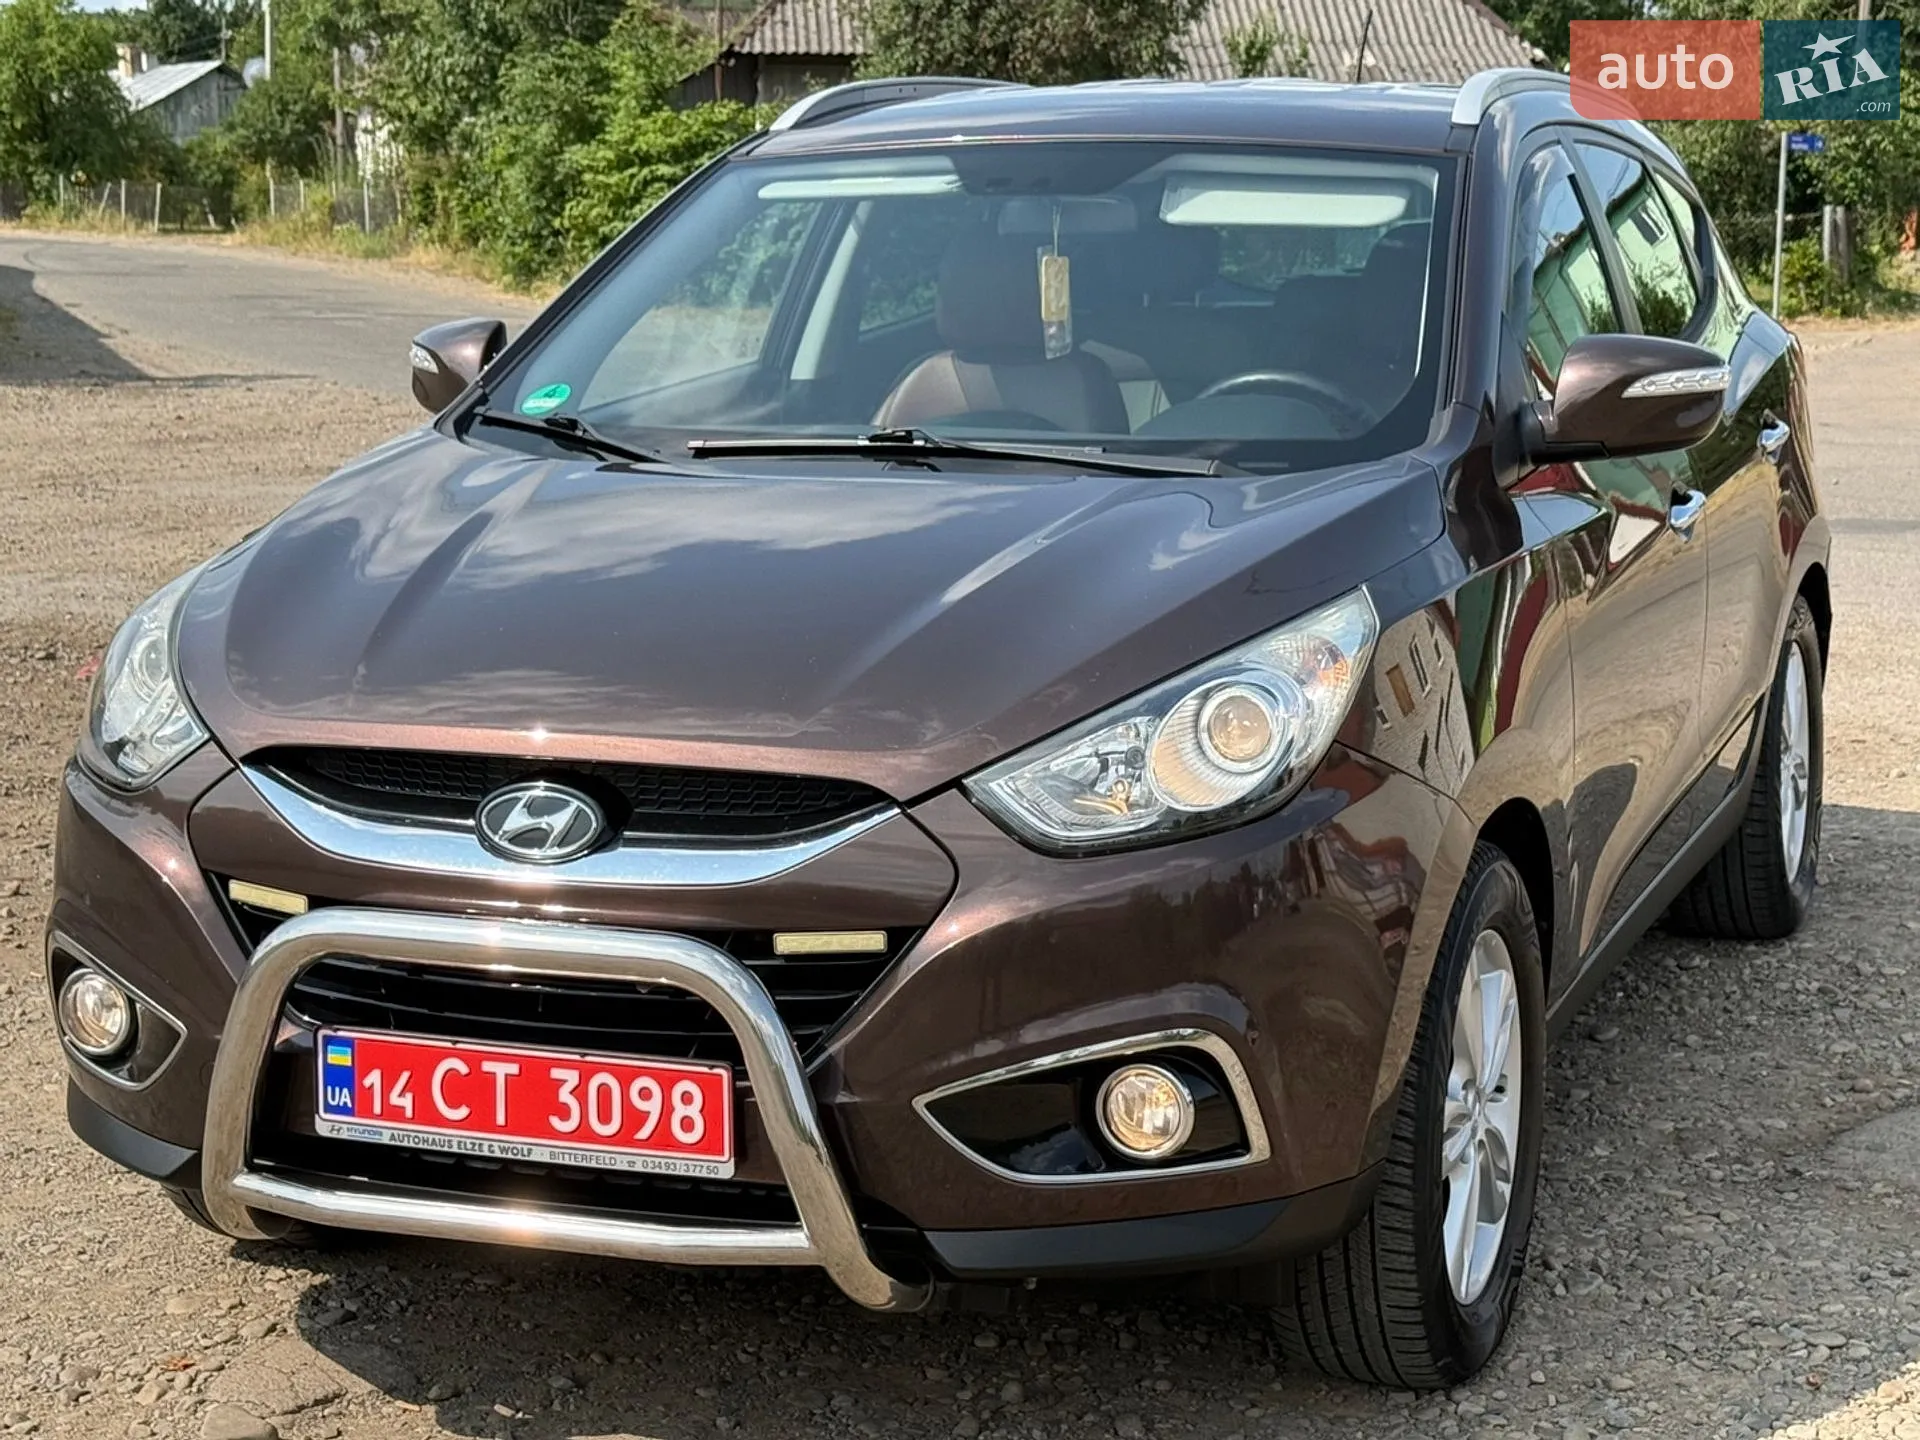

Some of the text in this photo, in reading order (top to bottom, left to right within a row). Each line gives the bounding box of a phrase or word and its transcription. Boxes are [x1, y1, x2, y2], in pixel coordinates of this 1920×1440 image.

[327, 1086, 352, 1108] UA
[361, 1057, 706, 1145] 14 CT 3098
[388, 1132, 454, 1149] AUTOHAUS
[456, 1140, 485, 1153] ELZE
[497, 1144, 534, 1158] WOLF
[549, 1150, 617, 1166] BITTERFELD
[641, 1159, 720, 1176] 03493/37750
